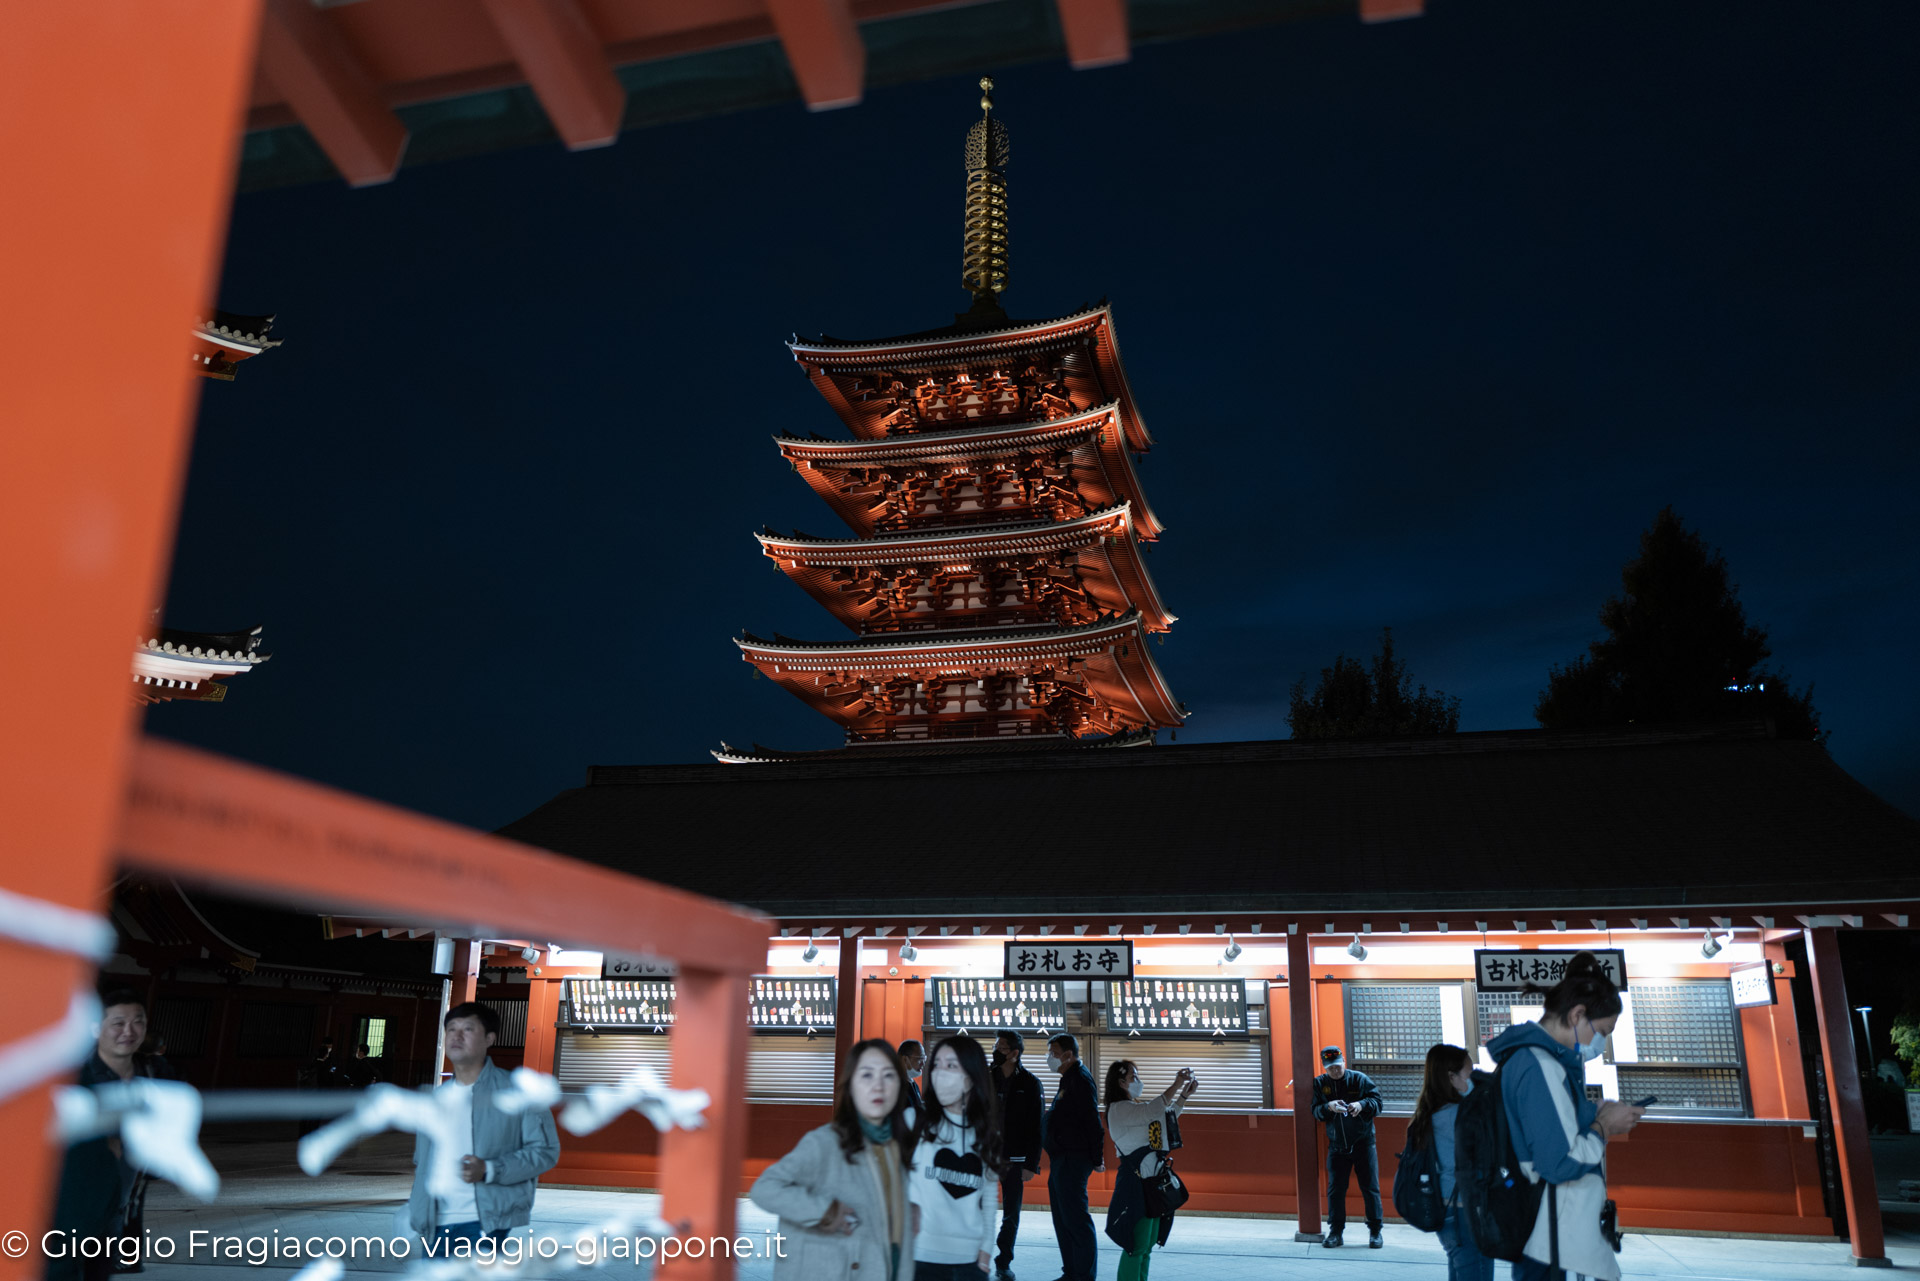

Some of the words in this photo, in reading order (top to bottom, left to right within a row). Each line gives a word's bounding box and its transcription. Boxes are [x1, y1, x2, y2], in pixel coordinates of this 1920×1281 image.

[1017, 948, 1120, 973] お札お守
[1485, 958, 1615, 982] 古札お納所
